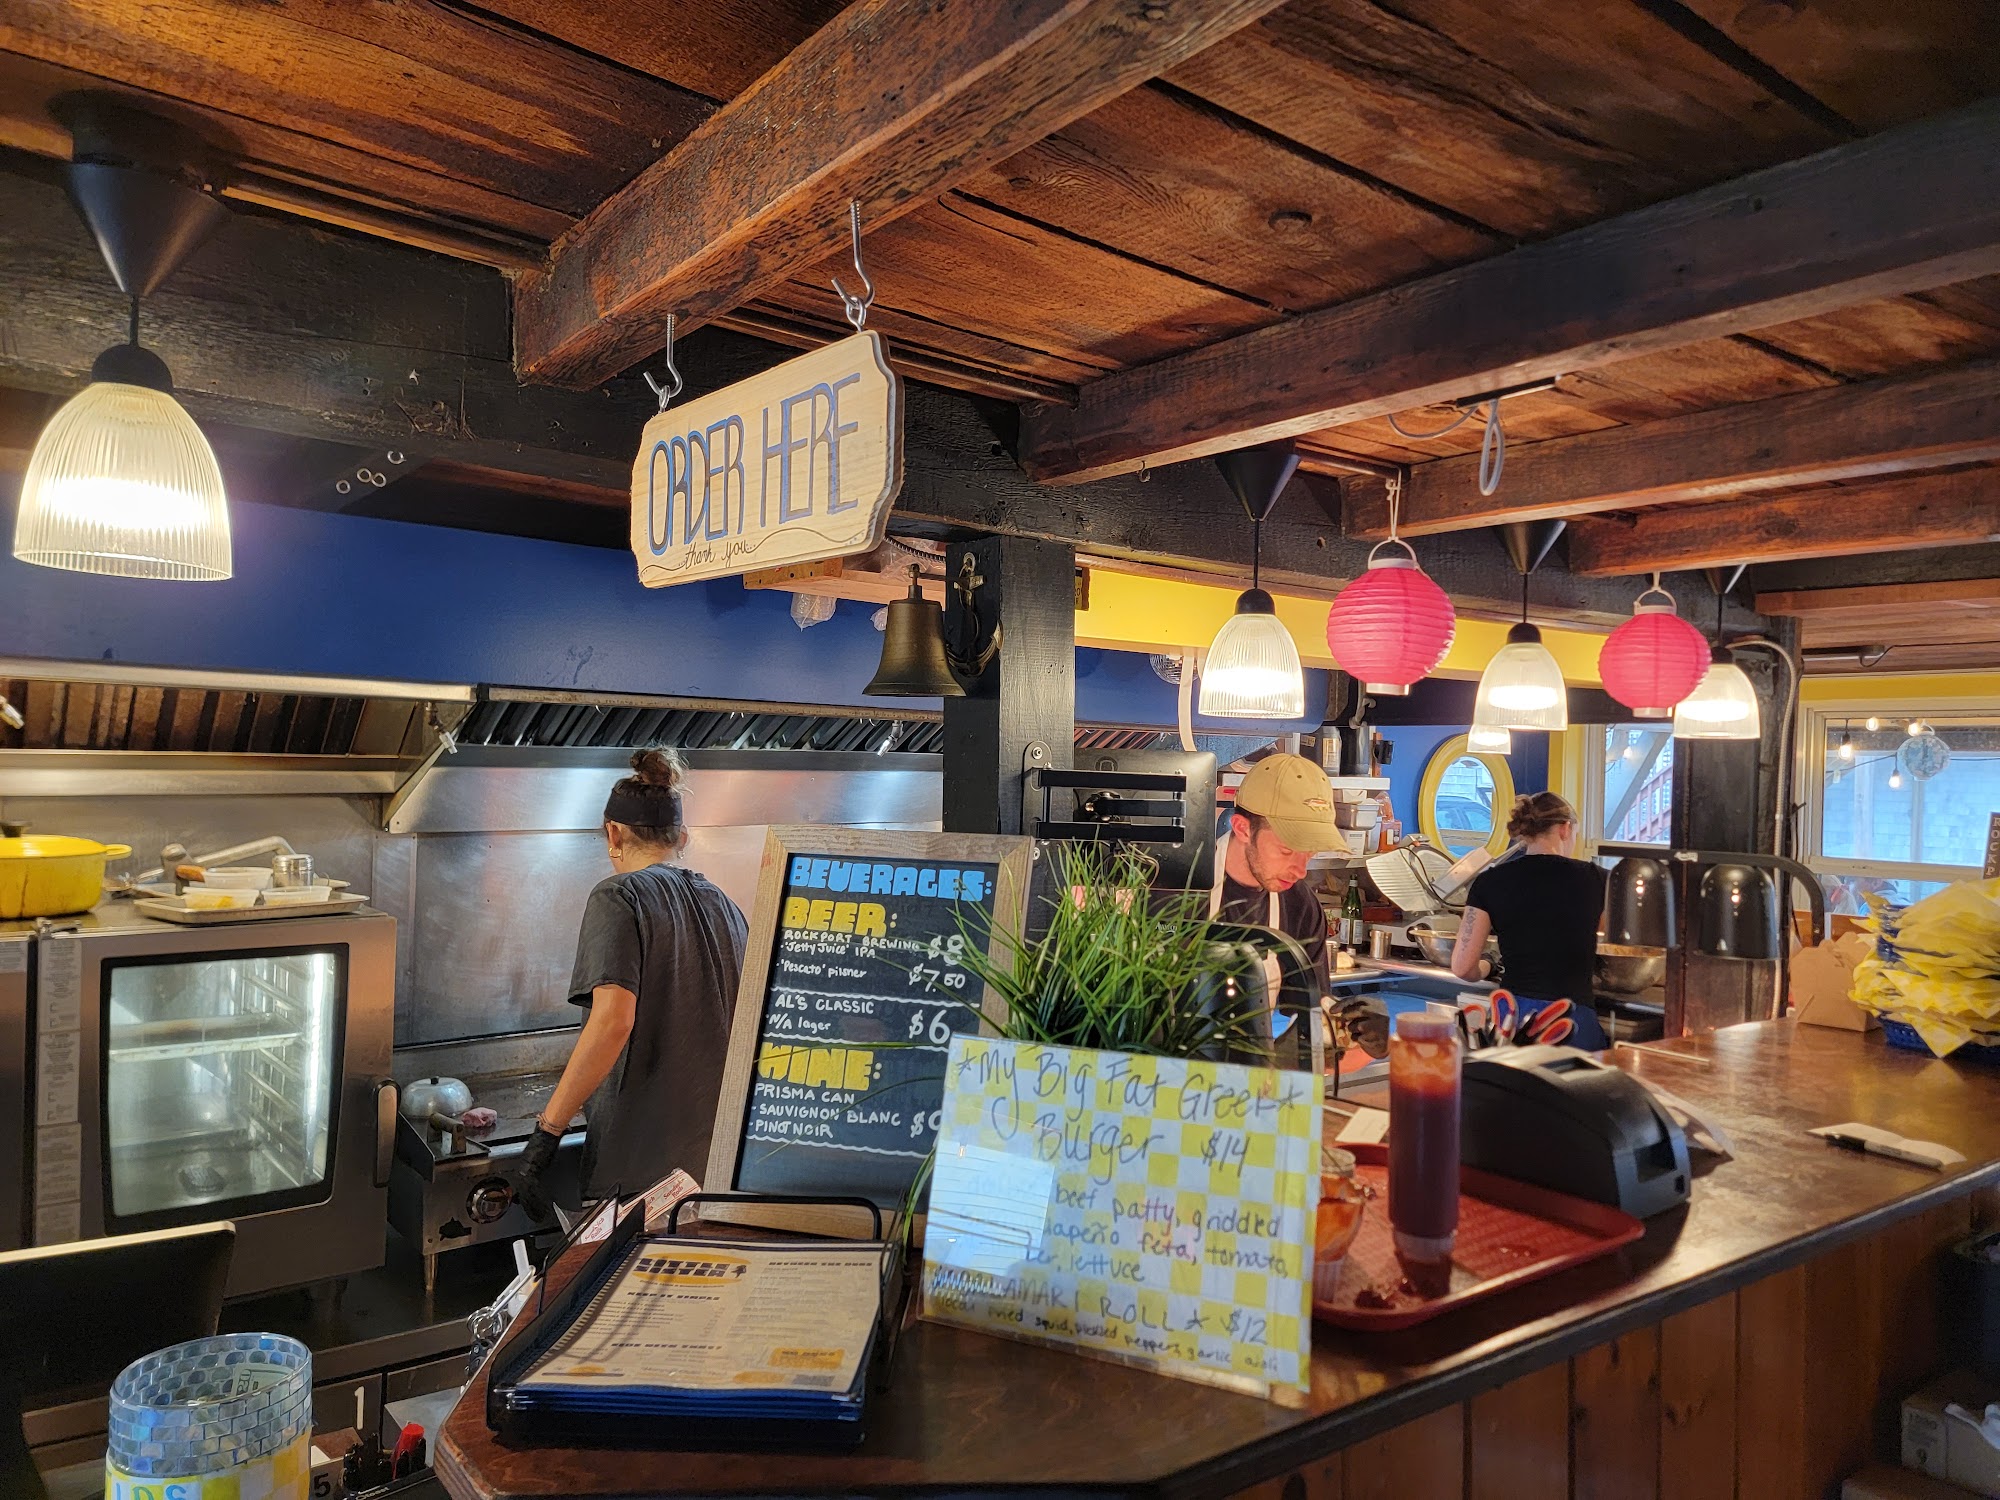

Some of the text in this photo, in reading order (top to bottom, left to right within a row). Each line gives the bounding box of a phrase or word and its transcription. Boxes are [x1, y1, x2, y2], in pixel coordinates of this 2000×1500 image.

[649, 372, 861, 556] ORDER HERE
[781, 896, 898, 938] BEER:
[855, 946, 876, 959] IPA
[862, 935, 920, 951] BREWING
[827, 966, 868, 979] pilsner
[797, 1017, 832, 1035] lager
[815, 997, 875, 1015] CLASSIC
[908, 1008, 950, 1045] $6
[757, 1041, 883, 1092] WINE:
[754, 1082, 855, 1105] PRISMA CAN
[979, 1049, 1020, 1141] My
[1032, 1052, 1093, 1123] Big
[1105, 1057, 1167, 1109] Fat
[759, 1102, 841, 1122] SAUVIGNON
[846, 1109, 901, 1126] BLANC
[1031, 1112, 1165, 1186] Burger
[1201, 1130, 1251, 1179] $14
[1055, 1183, 1098, 1210] beef
[1099, 1295, 1176, 1333] ROLL
[313, 1472, 332, 1498] 5
